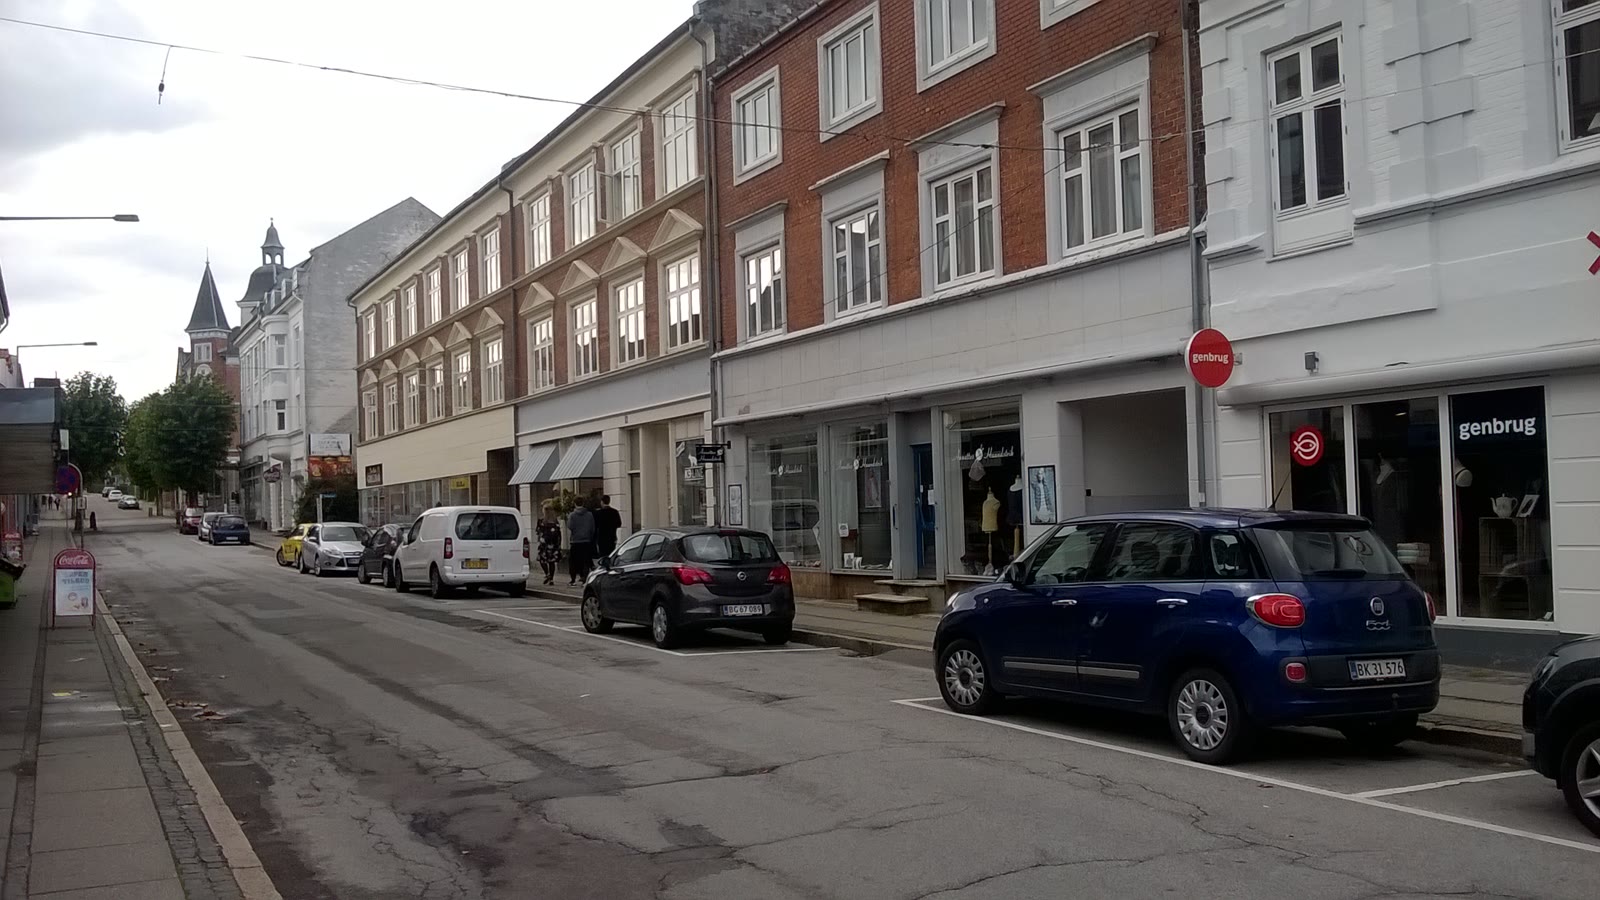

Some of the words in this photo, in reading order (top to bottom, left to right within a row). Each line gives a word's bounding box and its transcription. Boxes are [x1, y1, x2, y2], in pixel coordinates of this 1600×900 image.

[1192, 352, 1229, 365] genbrug
[1459, 417, 1537, 440] genbrug
[1357, 663, 1371, 676] BK
[1372, 662, 1384, 675] 31
[1385, 661, 1404, 674] 576
